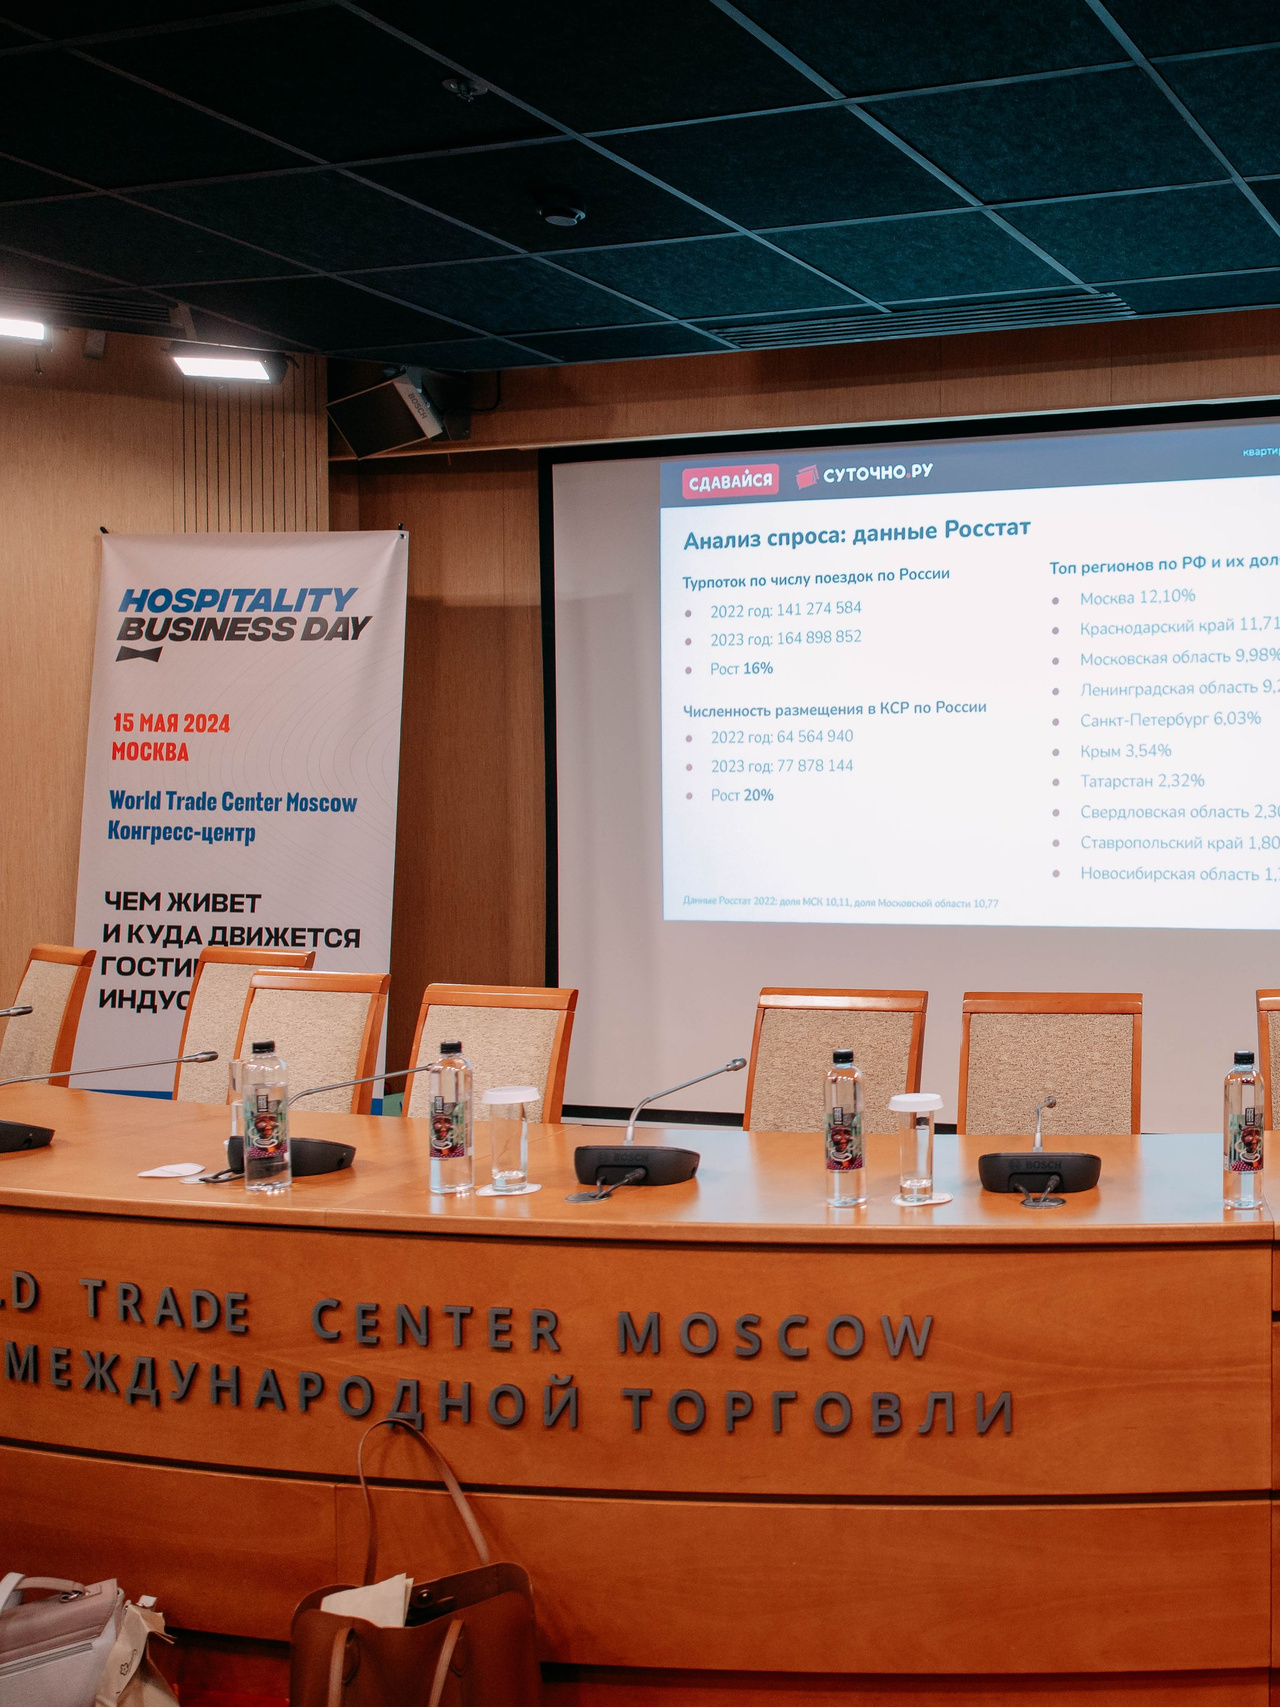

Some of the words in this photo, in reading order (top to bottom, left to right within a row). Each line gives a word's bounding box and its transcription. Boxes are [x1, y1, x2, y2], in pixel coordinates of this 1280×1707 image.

[408, 393, 428, 419] BOSCH
[689, 468, 773, 492] СДАВАЙСЯ
[823, 462, 933, 483] СУТОЧНО.РУ
[684, 531, 761, 550] Анализ
[767, 528, 846, 548] спроса:
[852, 523, 937, 545] данные
[945, 519, 1031, 538] Росстат
[1050, 561, 1077, 575] Топ
[1081, 561, 1154, 576] регионов
[1159, 559, 1177, 571] по
[1182, 556, 1207, 569] РФ
[1211, 557, 1221, 568] и
[1226, 556, 1245, 568] их
[683, 574, 746, 591] Турпоток
[750, 575, 766, 587] по
[770, 571, 810, 588] числу
[815, 570, 873, 586] поездок
[877, 569, 895, 583] по
[899, 567, 950, 581] России
[118, 587, 359, 613] HOSPITALITY
[1080, 592, 1135, 605] Москва
[1140, 588, 1196, 604] 12,10%
[710, 603, 744, 618] 2022
[748, 605, 774, 620] год:
[777, 603, 801, 616] 141
[806, 602, 832, 615] 274
[836, 601, 862, 614] 584
[116, 616, 297, 642] BUSINESS
[300, 616, 373, 641] DAY
[1080, 619, 1194, 636] Краснодарский
[1199, 618, 1235, 634] край
[1240, 616, 1280, 631] 11,71
[710, 632, 744, 647] 2023
[748, 634, 774, 649] год:
[777, 631, 803, 645] 164
[806, 630, 832, 644] 898
[835, 629, 862, 643] 852
[1080, 653, 1168, 666] Московская
[1172, 650, 1231, 664] область
[710, 663, 740, 676] Рост
[743, 661, 774, 675] 16%
[1080, 683, 1195, 698] Ленинградская
[1199, 680, 1258, 695] область
[683, 704, 771, 718] Численность
[775, 702, 864, 719] размещения
[868, 704, 876, 715] в
[880, 701, 909, 714] КСР
[914, 703, 931, 714] по
[936, 700, 987, 713] России
[114, 713, 134, 732] 15
[140, 713, 178, 732] МАЯ
[184, 714, 230, 733] 2024
[1080, 712, 1209, 728] Санкт-Петербург
[1213, 711, 1262, 726] 6,03%
[711, 731, 745, 744] 2022
[748, 733, 774, 746] год:
[777, 730, 794, 743] 64
[798, 730, 824, 743] 564
[827, 729, 854, 742] 940
[112, 741, 189, 762] МОСКВА
[1080, 745, 1121, 760] Крым
[1126, 743, 1172, 758] 3,54%
[711, 759, 745, 773] 2023
[748, 761, 774, 774] год:
[777, 759, 793, 772] 77
[797, 759, 824, 772] 878
[828, 759, 854, 772] 144
[1080, 774, 1154, 790] Татарстан
[1158, 773, 1205, 788] 2,32%
[110, 790, 161, 810] World
[166, 791, 216, 811] Trade
[222, 792, 282, 812] Center
[286, 792, 358, 812] Moscow
[711, 789, 741, 802] Рост
[743, 788, 774, 802] 20%
[1080, 805, 1186, 821] Свердловская
[1190, 804, 1250, 818] область
[108, 820, 255, 846] Конгресс-центр
[1080, 836, 1203, 852] Ставропольский
[1207, 836, 1243, 852] край
[1080, 866, 1196, 882] Новосибирская
[1200, 867, 1260, 881] область
[104, 891, 161, 911] ЧЕМ
[167, 892, 262, 913] ЖИВЕТ
[683, 895, 717, 906] Данные
[719, 896, 751, 905] Росстат
[753, 896, 778, 906] 2022:
[779, 898, 800, 907] доля
[802, 897, 824, 906] МСК
[854, 899, 876, 908] доля
[878, 898, 933, 908] Московской
[935, 898, 971, 908] области
[974, 898, 999, 909] 10,77
[102, 923, 121, 944] И
[128, 924, 202, 949] КУДА
[208, 926, 361, 948] ДВИЖЕТСЯ
[614, 1153, 649, 1162] BOSCH
[1025, 1160, 1062, 1170] BOSCH
[0, 1271, 37, 1309] D
[79, 1278, 248, 1334] TRADE
[311, 1299, 560, 1352] CENTER
[617, 1311, 932, 1358] MOSCOW
[4, 1341, 579, 1431] МЕЖДУНАРОДНОЙ
[622, 1388, 1012, 1434] ТОРГОВЛИ
